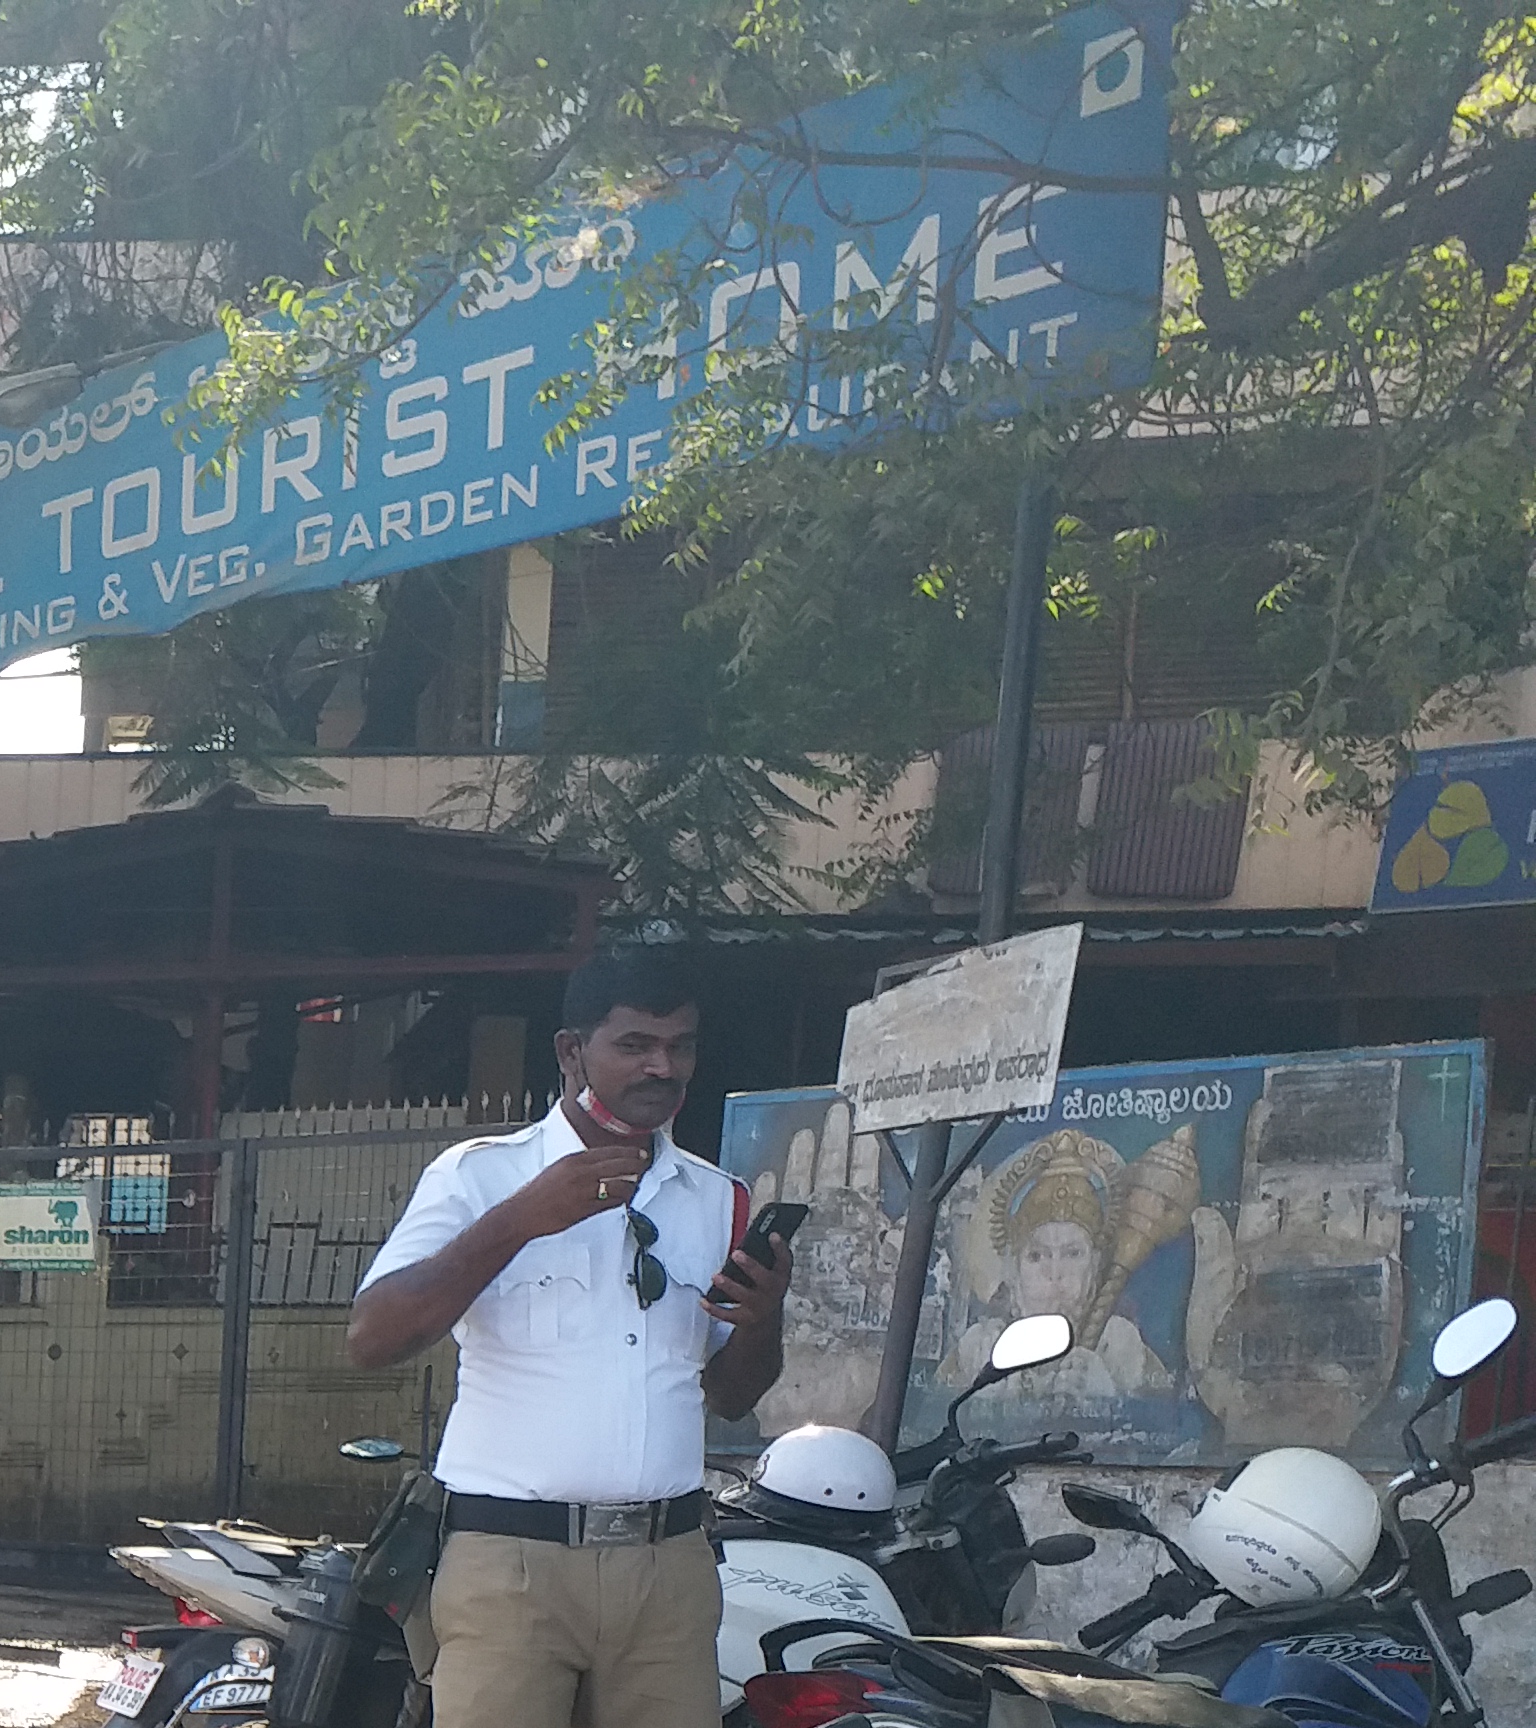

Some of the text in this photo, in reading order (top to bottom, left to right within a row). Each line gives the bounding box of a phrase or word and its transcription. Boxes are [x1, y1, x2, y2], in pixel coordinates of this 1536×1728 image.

[42, 346, 534, 574] TOURIST
[98, 573, 129, 620] &
[152, 545, 266, 604] VEG.
[294, 466, 539, 566] GARDEN
[3, 1225, 89, 1244] sharon
[1275, 1634, 1433, 1662] Passion
[203, 1688, 224, 1706] EF
